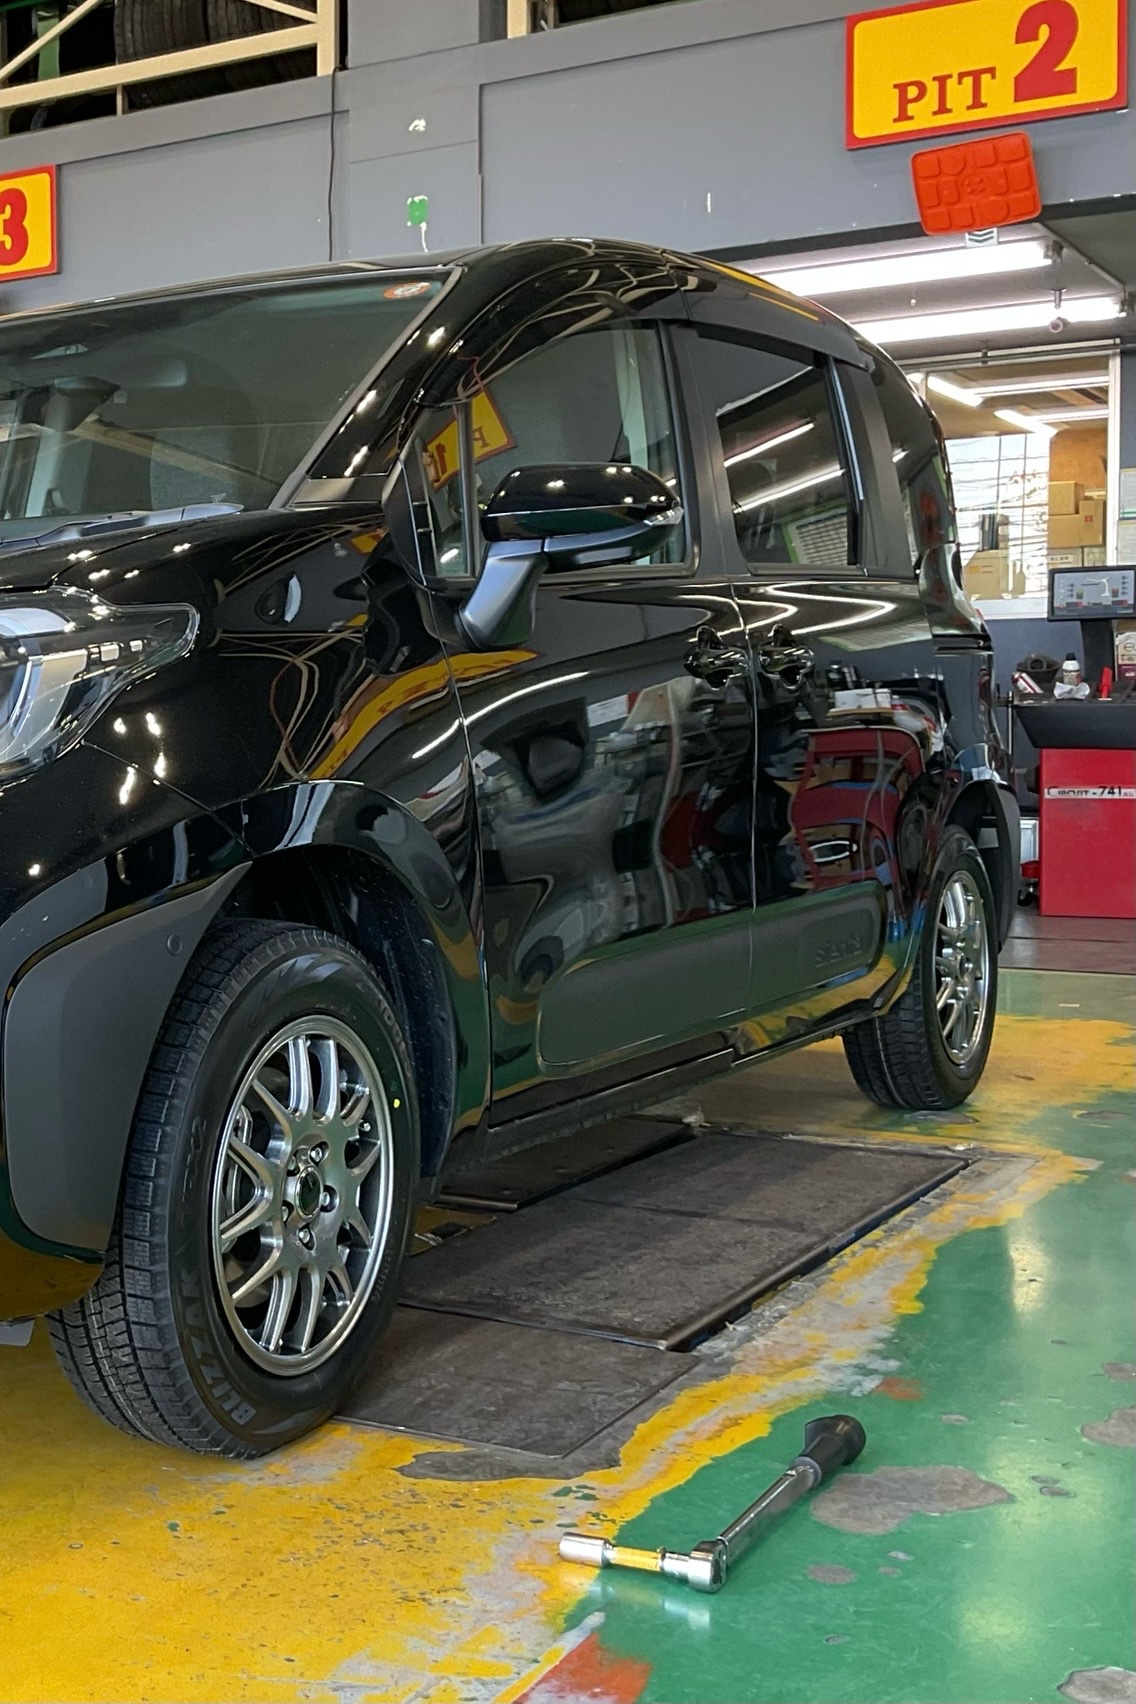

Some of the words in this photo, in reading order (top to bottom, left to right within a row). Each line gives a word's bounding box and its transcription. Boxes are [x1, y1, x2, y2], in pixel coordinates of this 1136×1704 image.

[892, 66, 997, 123] PIT
[1014, 0, 1079, 102] 2
[180, 1266, 257, 1426] BLIZZAK
